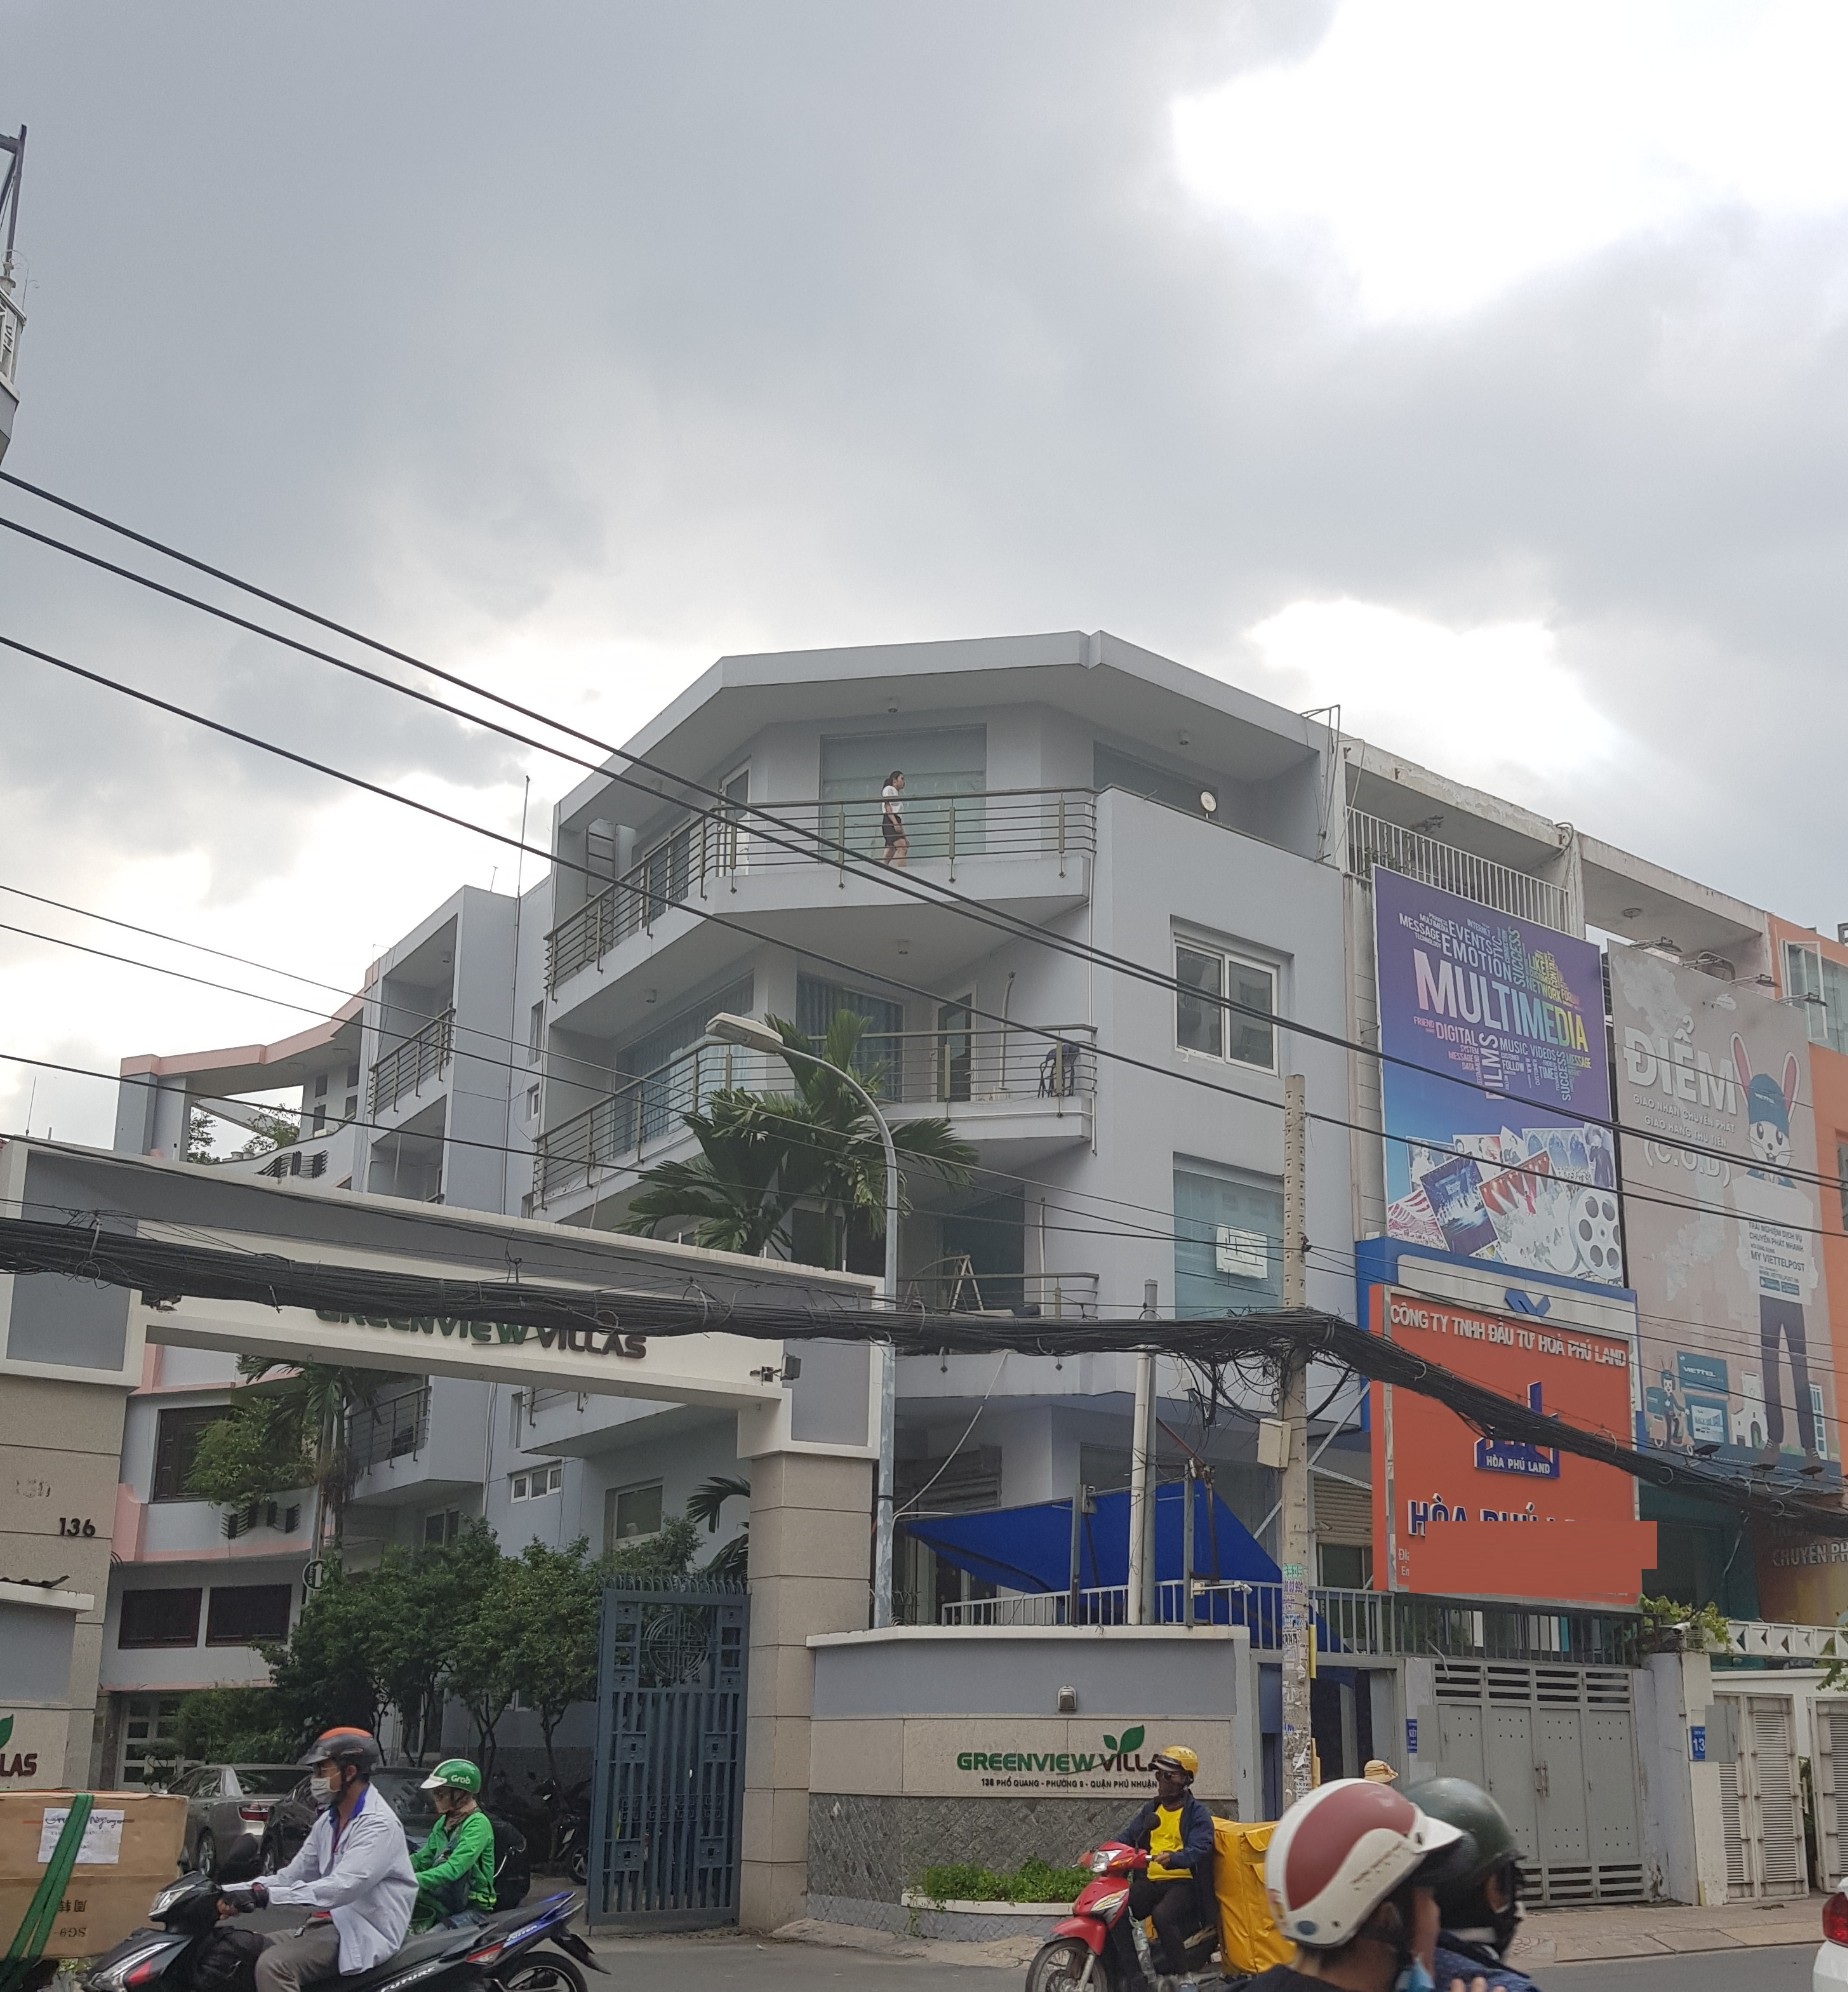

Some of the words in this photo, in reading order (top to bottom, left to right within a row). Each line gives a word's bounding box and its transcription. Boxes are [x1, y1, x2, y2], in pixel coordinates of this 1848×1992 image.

[1399, 912, 1442, 942] MESSAGE
[1448, 920, 1493, 955] EVENTS
[1441, 934, 1513, 982] EMOTION
[1507, 926, 1527, 988] SUCCESS
[1413, 948, 1589, 1053] MULTIMEDIA
[1435, 1021, 1479, 1047] DIGITAL
[1499, 1037, 1528, 1056] MUSIC
[1529, 1043, 1557, 1061] VIDEOS
[1556, 1051, 1572, 1101] SUCCESS
[1622, 1014, 1738, 1116] ĐIỂM
[1633, 1094, 1655, 1109] GIAO
[1645, 1115, 1666, 1130] GIAO
[1763, 1253, 1805, 1272] VIETTELPOST
[538, 1325, 647, 1359] VILLAS
[1390, 1302, 1429, 1329] CÔNG
[1430, 1312, 1448, 1333] TY
[1451, 1317, 1486, 1340] TNHH
[1516, 1329, 1536, 1350] TƯ
[1567, 1338, 1592, 1361] PHÚ
[1594, 1345, 1628, 1367] LAND
[1486, 1454, 1504, 1468] HÒA
[1528, 1461, 1551, 1475] LAND
[59, 1516, 97, 1538] 136
[956, 1751, 1096, 1772] GREENVIEW
[450, 1774, 471, 1785] Grab
[1013, 1779, 1040, 1788] QUANG
